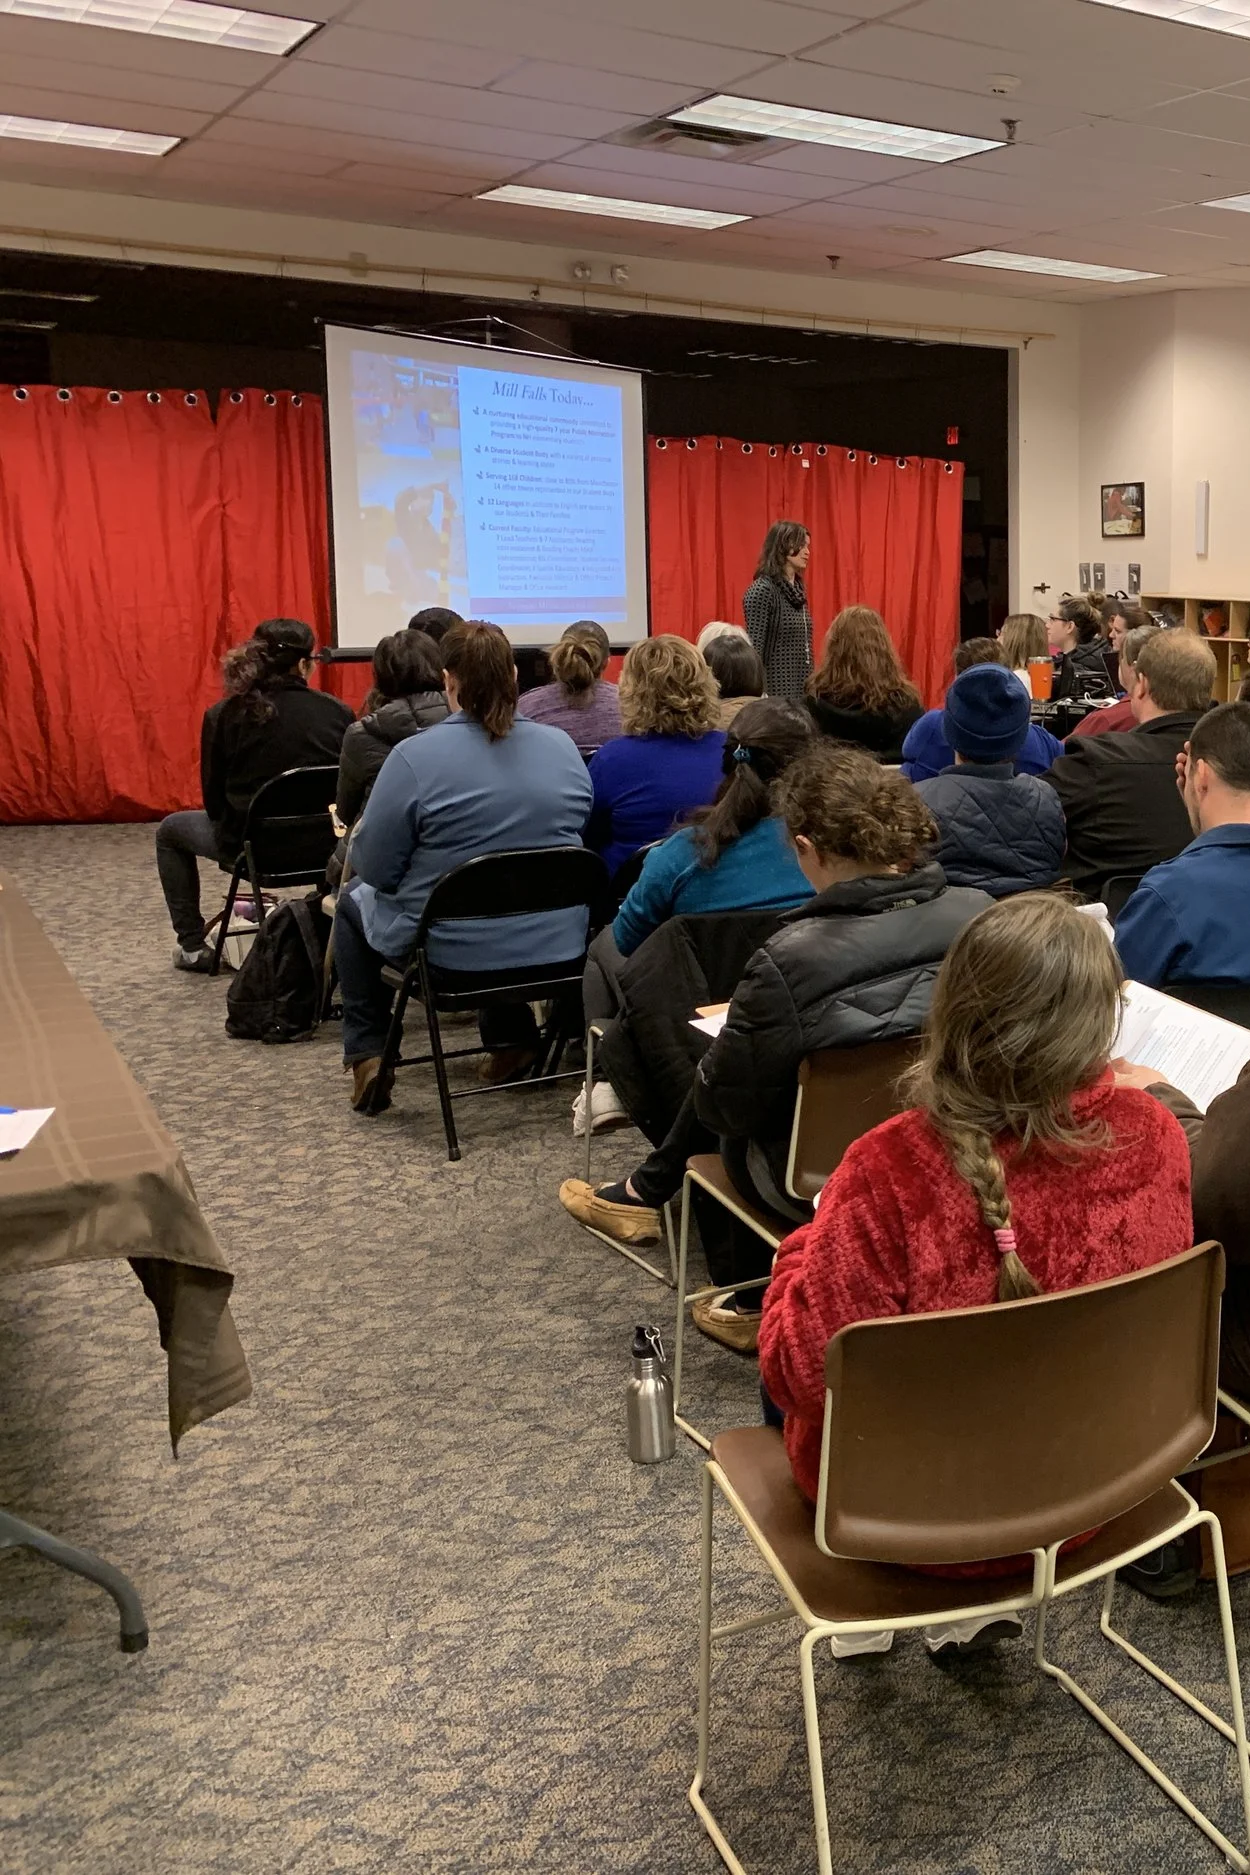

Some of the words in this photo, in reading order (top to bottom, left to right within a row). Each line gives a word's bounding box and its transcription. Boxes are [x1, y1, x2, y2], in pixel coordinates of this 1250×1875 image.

[492, 380, 518, 398] Mill
[522, 385, 547, 401] Falls
[548, 387, 594, 407] Today...
